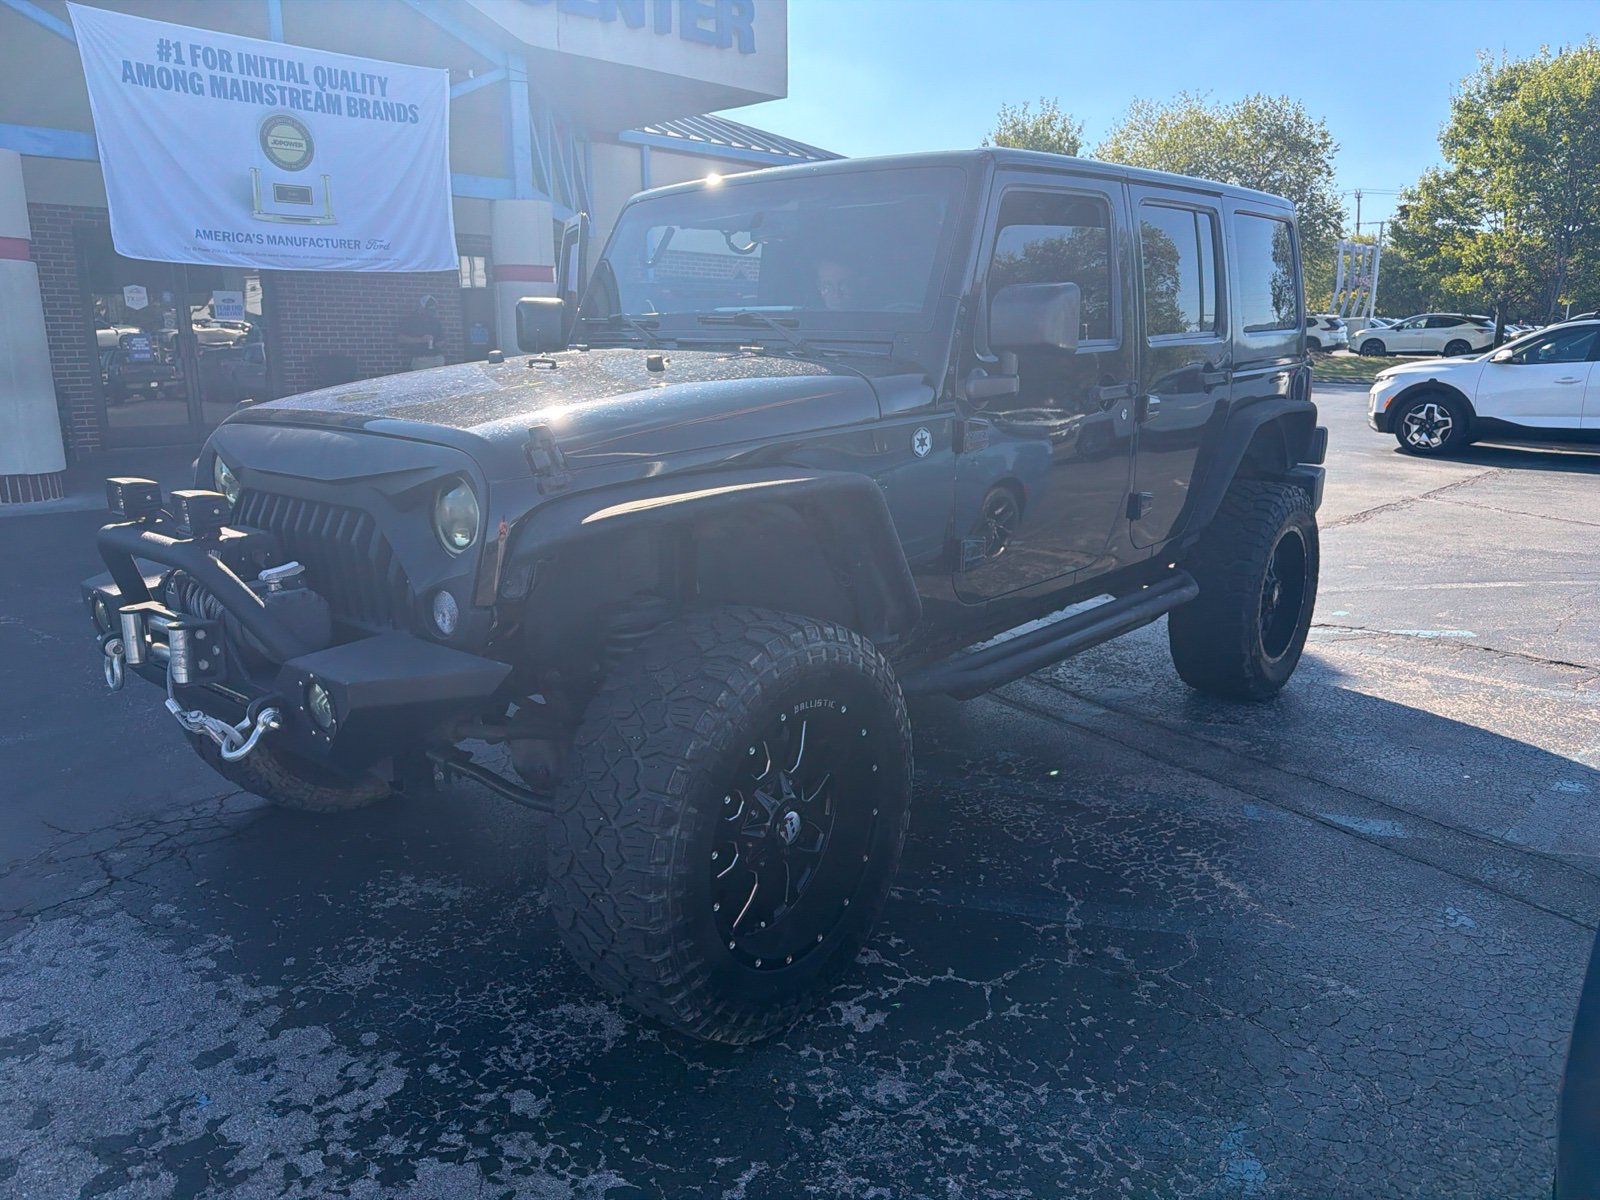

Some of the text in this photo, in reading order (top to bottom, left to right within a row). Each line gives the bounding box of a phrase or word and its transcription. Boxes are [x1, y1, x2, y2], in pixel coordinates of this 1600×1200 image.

[157, 38, 389, 98] #1 FOR INITIAL QUALITY
[122, 60, 420, 125] AMONG MAINSTREAM BRANDS
[194, 228, 392, 251] AMERICA'S MANUFACTURER Ford
[794, 699, 836, 714] BALLISTIC
